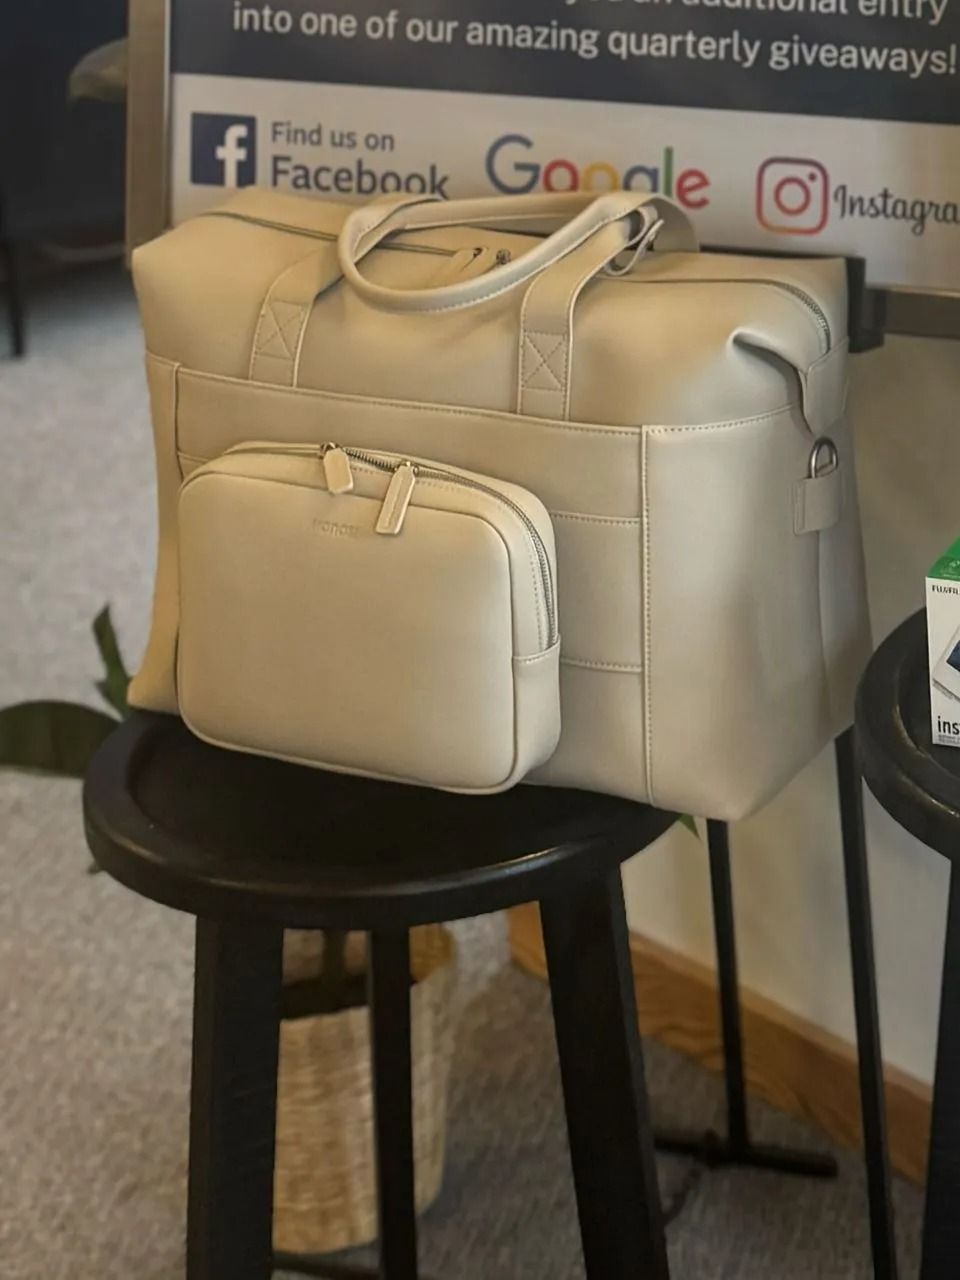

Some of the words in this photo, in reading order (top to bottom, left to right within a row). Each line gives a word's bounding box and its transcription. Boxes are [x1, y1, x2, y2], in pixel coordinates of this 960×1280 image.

[232, 1, 293, 35] into
[300, 11, 357, 38] one
[365, 5, 399, 40] of
[405, 17, 458, 45] our
[465, 16, 600, 58] amazing
[608, 25, 761, 68] quarterly
[768, 37, 958, 76] giveaways!
[270, 122, 321, 148] Find
[330, 130, 357, 150] us
[364, 134, 395, 152] on
[270, 155, 451, 200] Facebook
